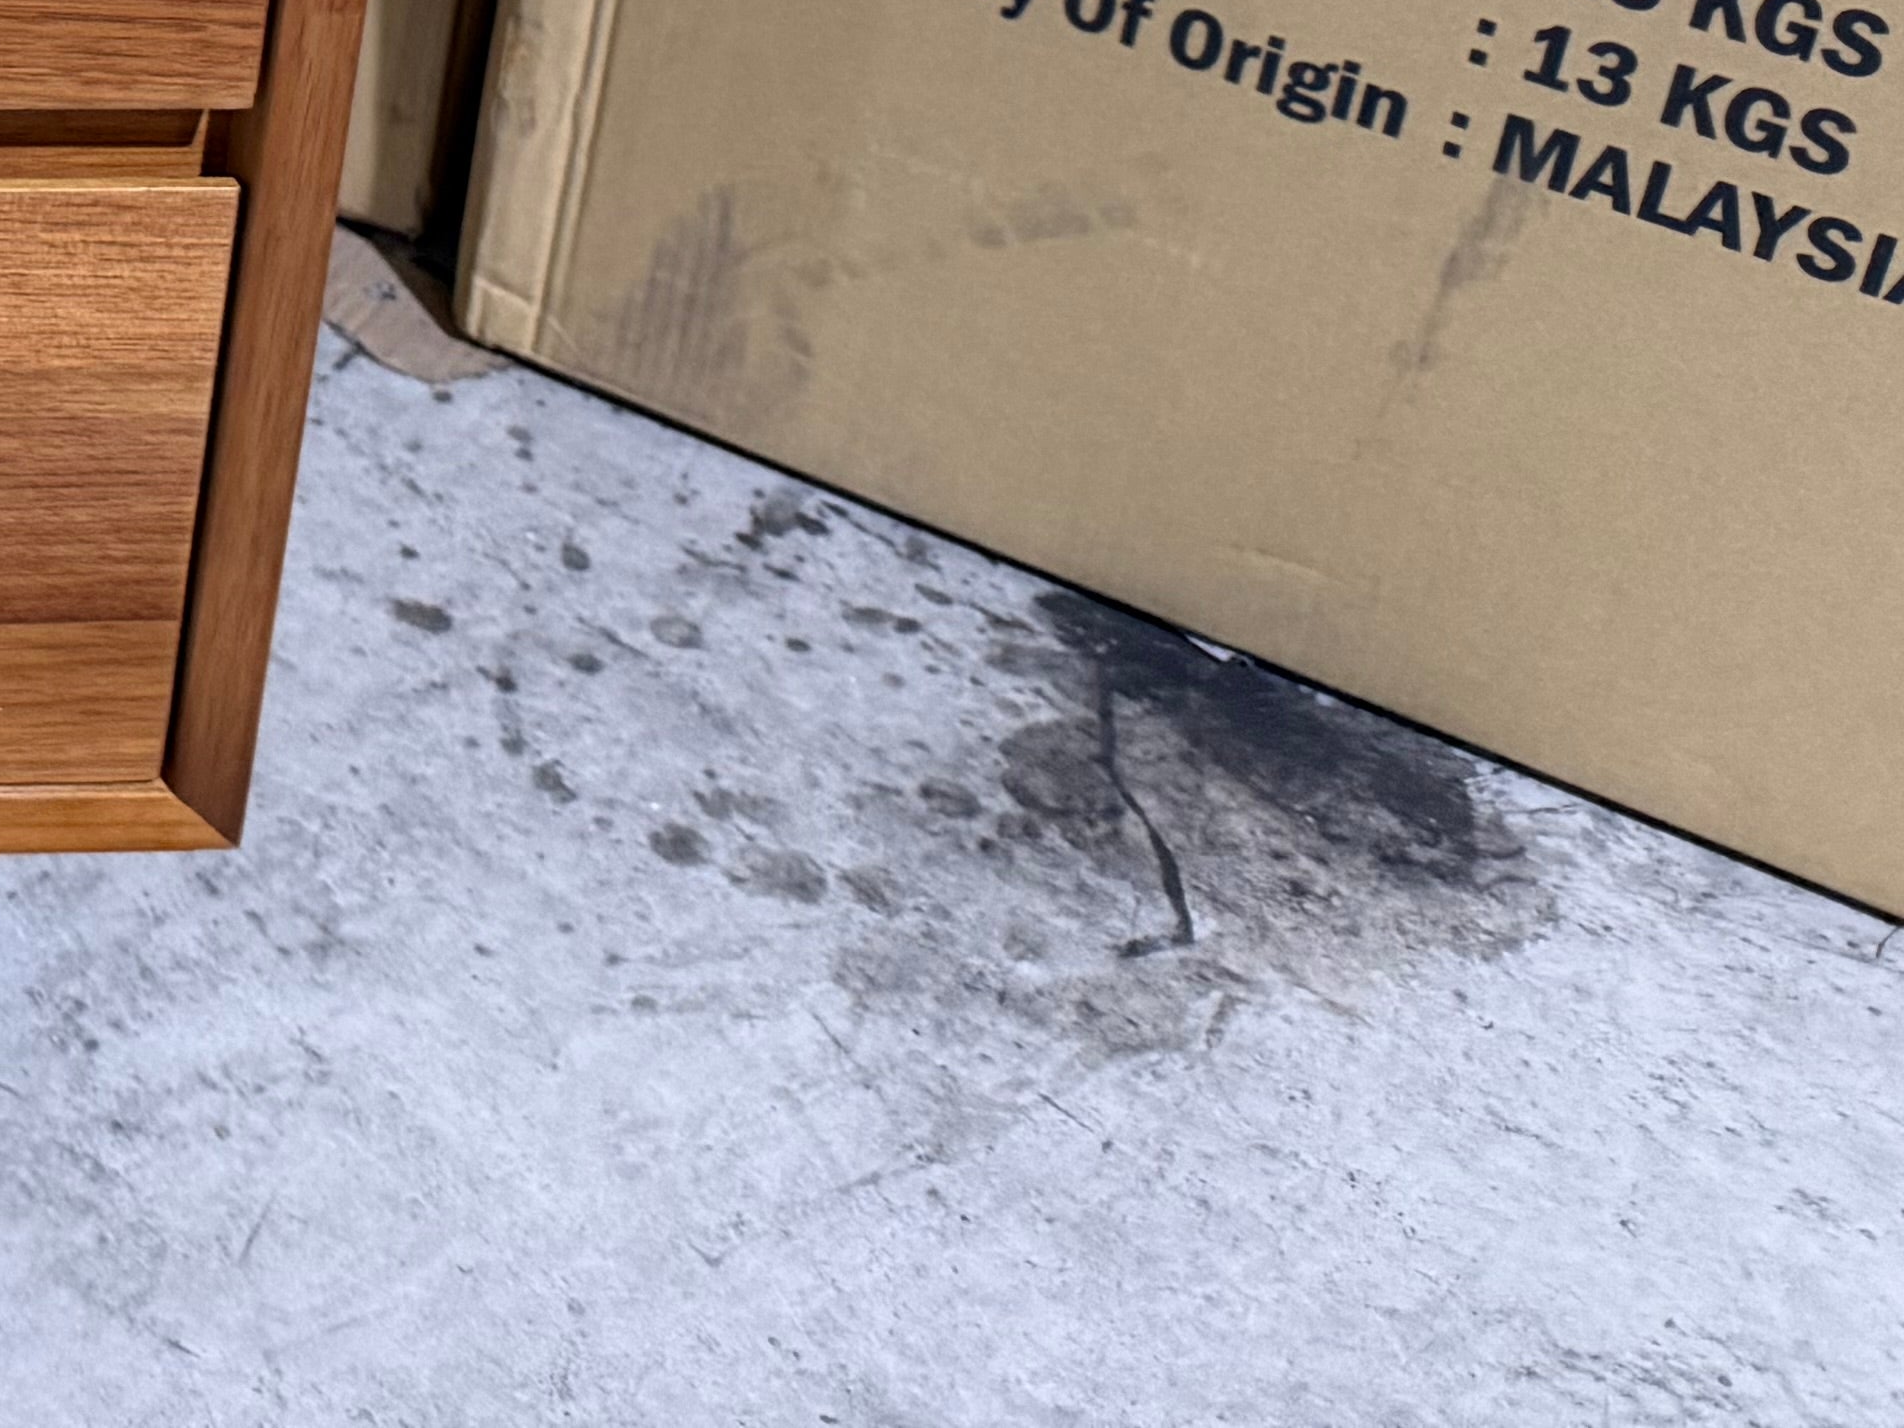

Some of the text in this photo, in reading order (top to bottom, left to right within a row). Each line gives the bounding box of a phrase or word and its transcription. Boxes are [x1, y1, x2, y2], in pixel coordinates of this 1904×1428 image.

[1168, 7, 1409, 140] Origin
[1490, 112, 1904, 306] MALAYSI
[1522, 24, 1640, 108] 13
[1658, 62, 1858, 176] KGS
